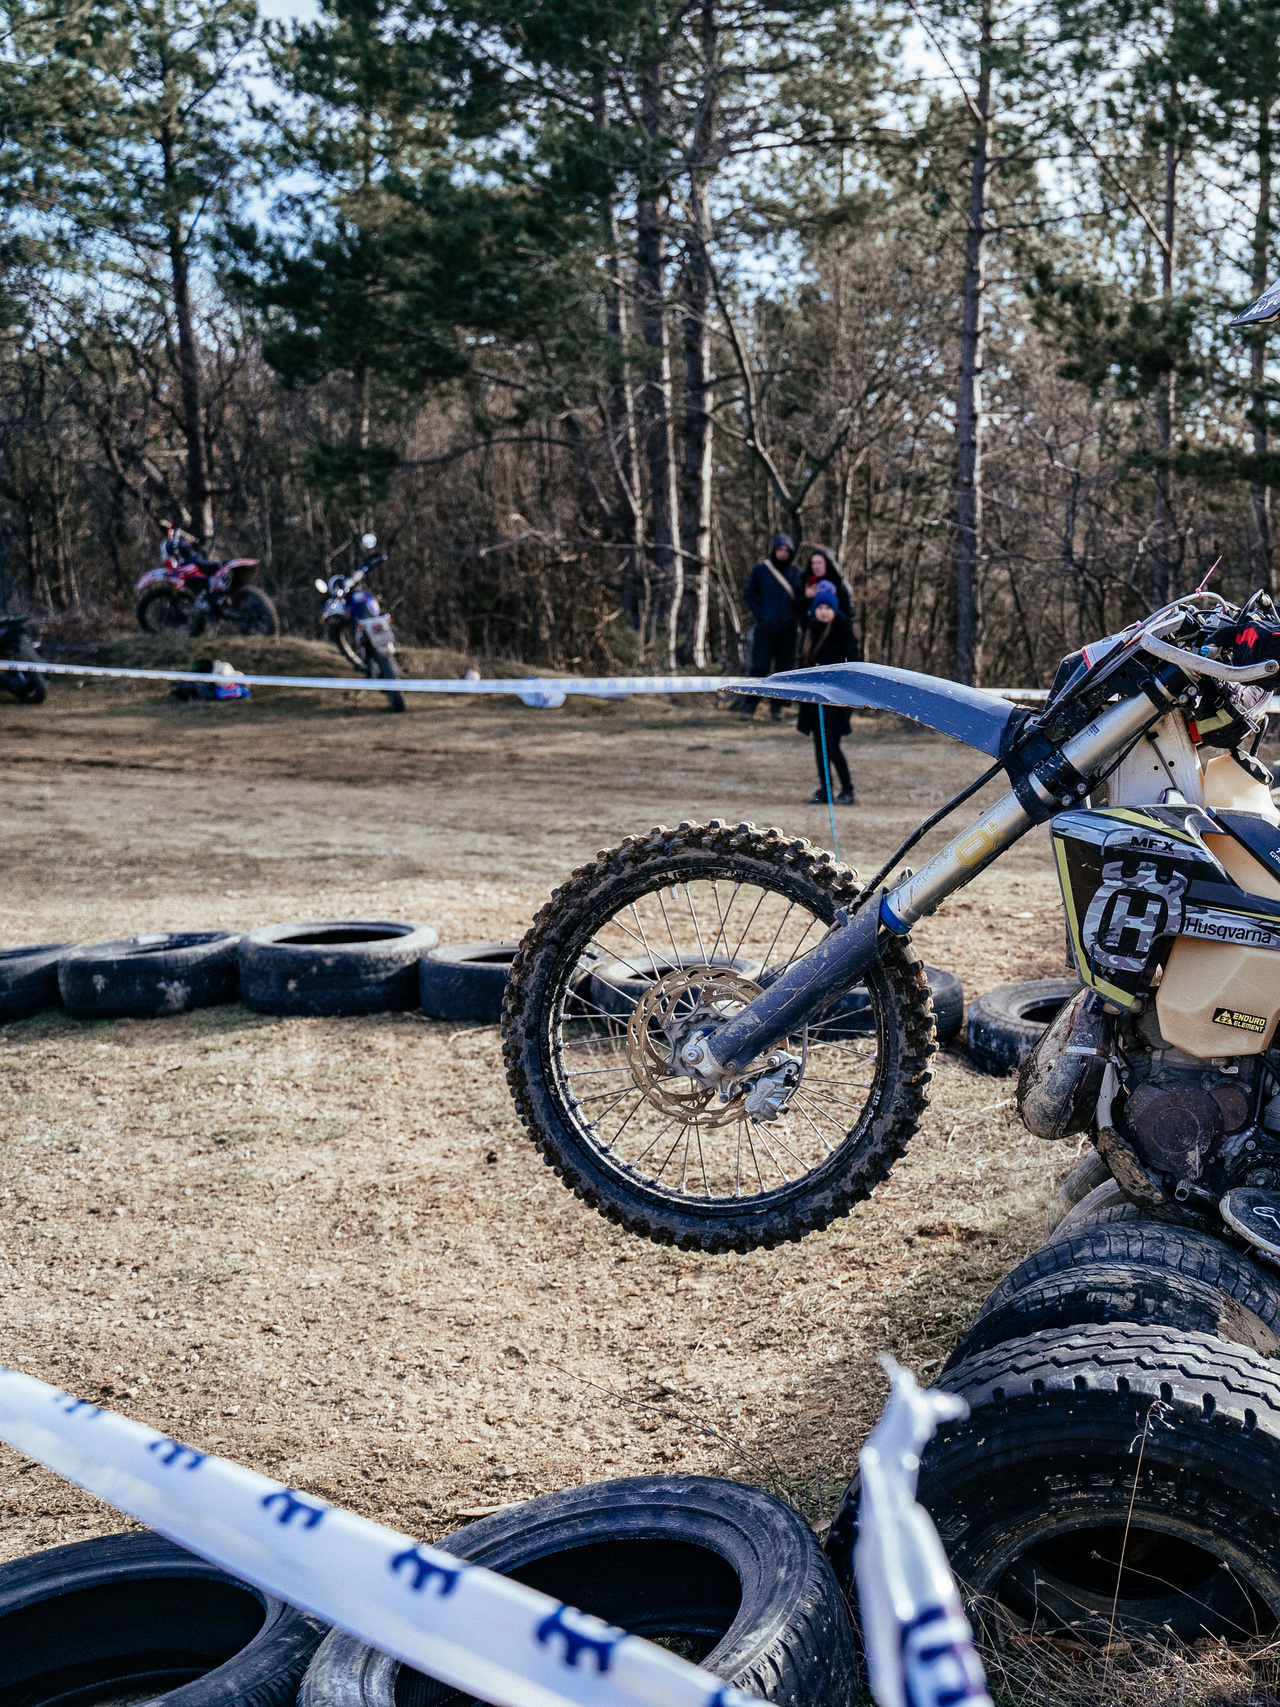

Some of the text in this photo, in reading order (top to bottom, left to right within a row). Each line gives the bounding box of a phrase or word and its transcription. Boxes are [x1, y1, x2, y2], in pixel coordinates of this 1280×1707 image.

[1130, 836, 1175, 852] MFX
[1186, 917, 1272, 944] Husqvarna
[1232, 1012, 1266, 1026] ENDURO
[1233, 1020, 1264, 1032] ELEMENT
